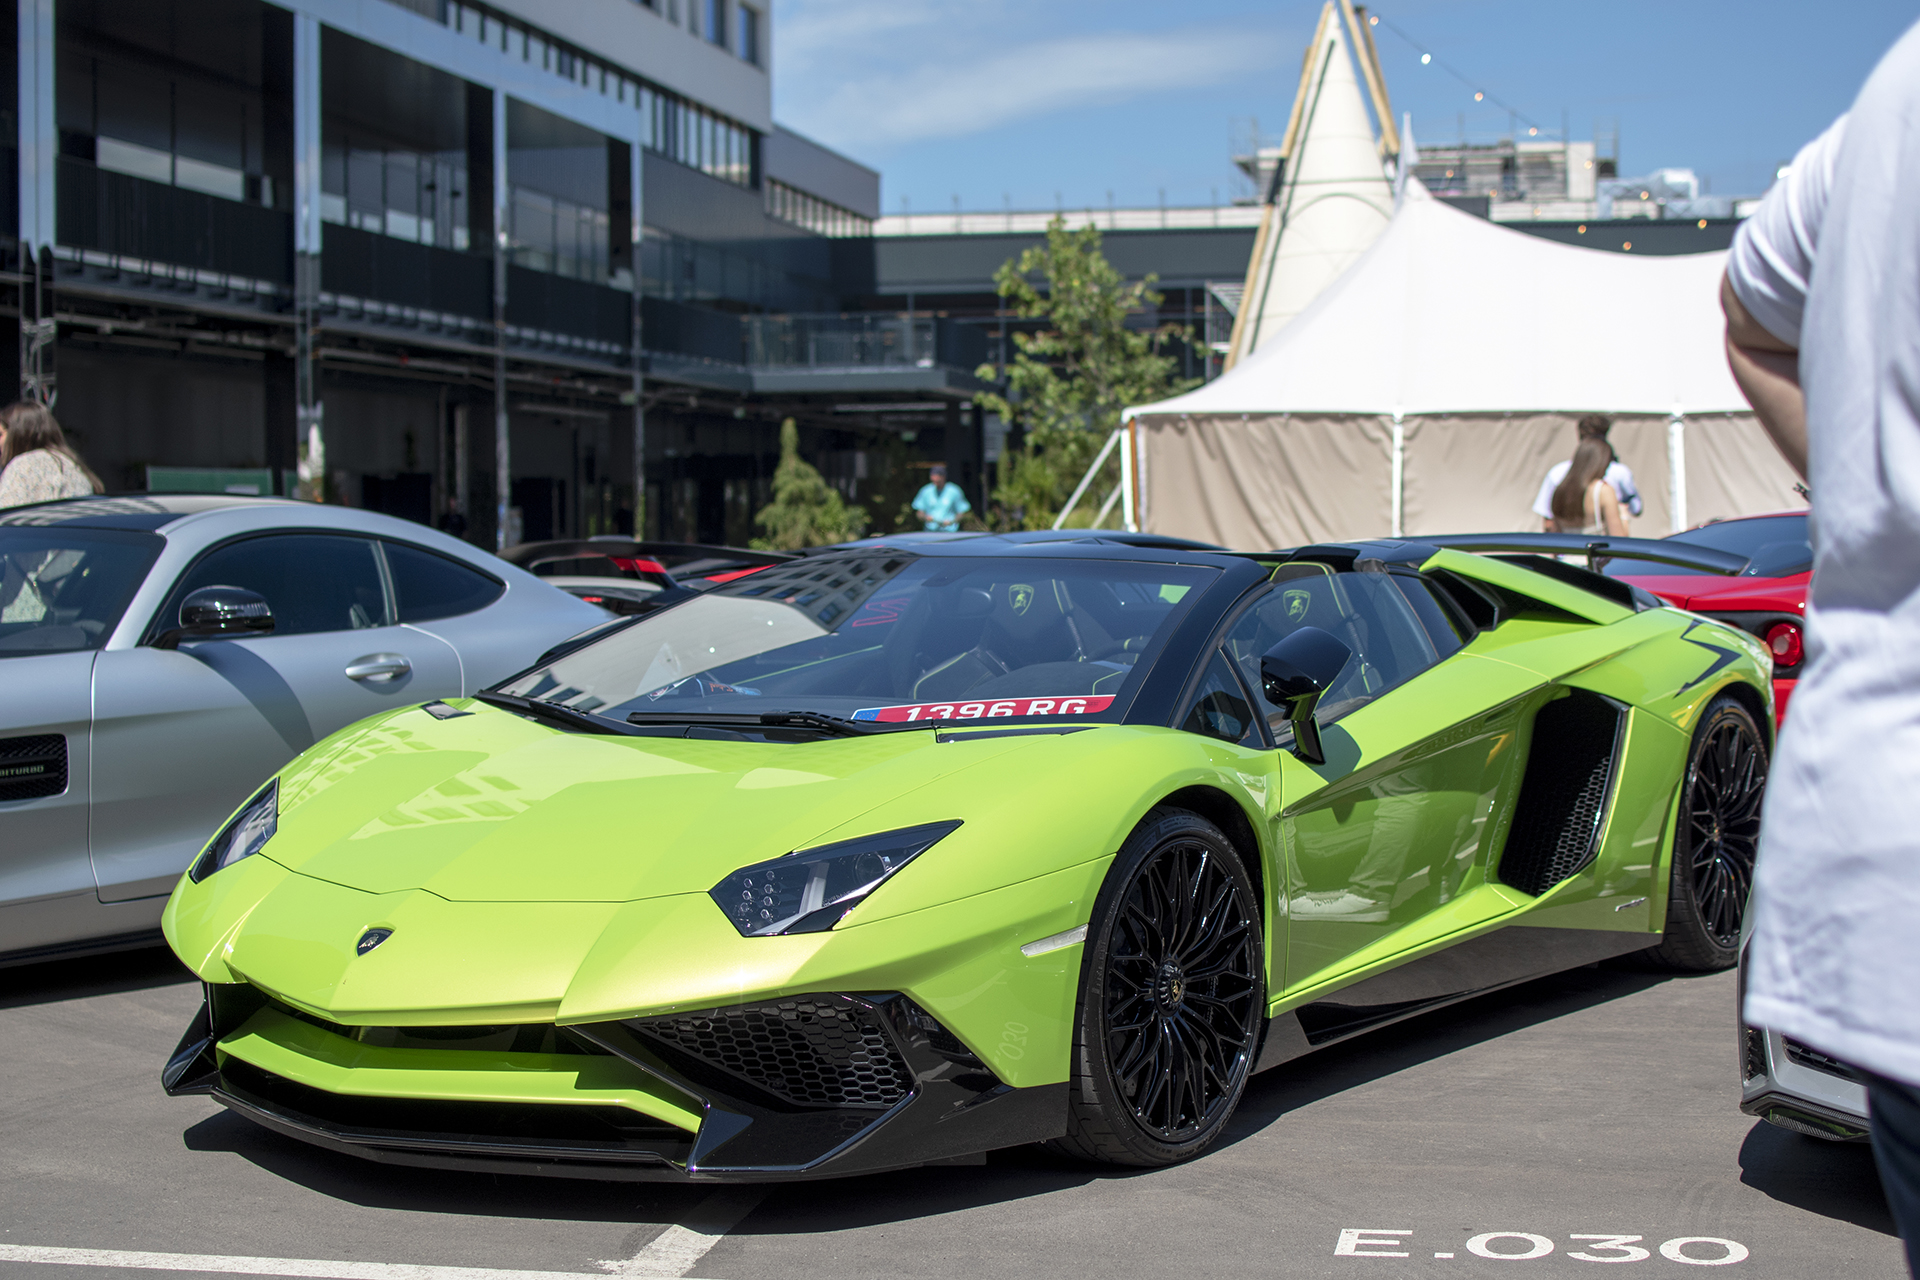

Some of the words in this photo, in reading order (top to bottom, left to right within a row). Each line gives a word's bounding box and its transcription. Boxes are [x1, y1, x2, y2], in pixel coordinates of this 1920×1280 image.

[906, 702, 1016, 722] 1396
[1026, 699, 1087, 716] RG
[1333, 1228, 1750, 1266] E.030
